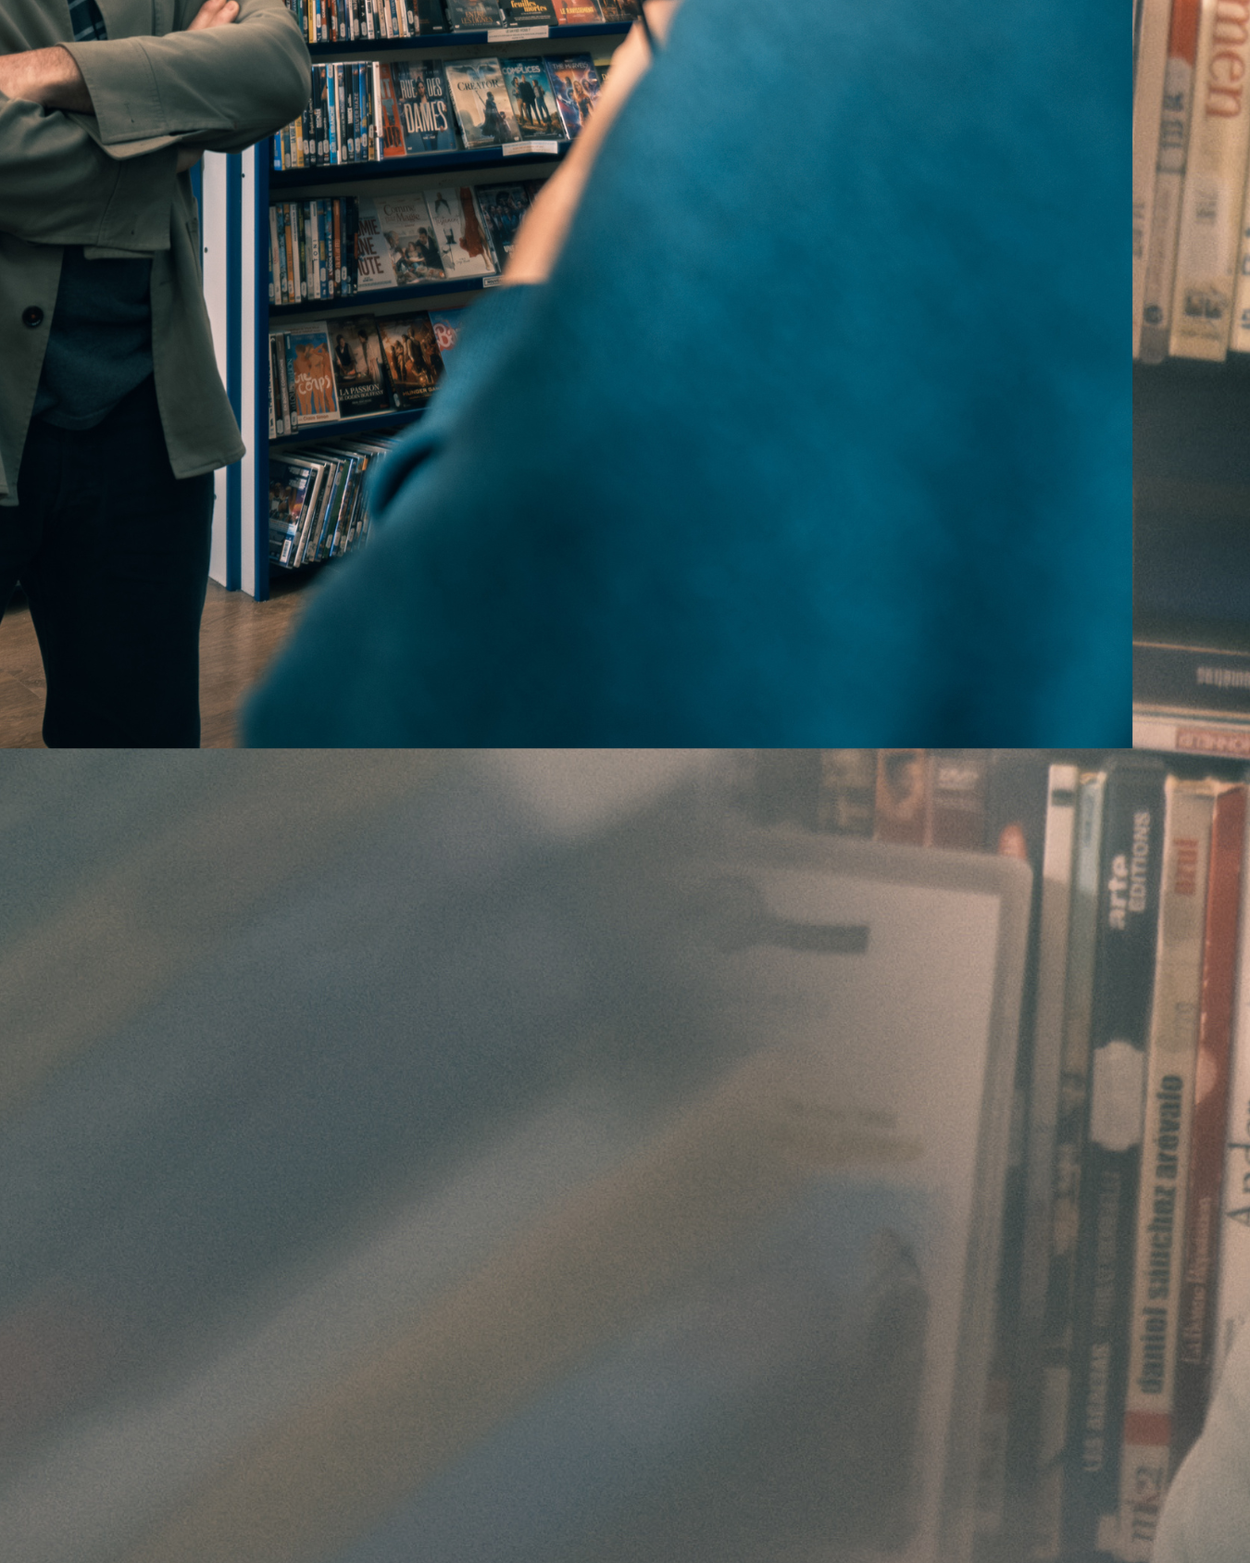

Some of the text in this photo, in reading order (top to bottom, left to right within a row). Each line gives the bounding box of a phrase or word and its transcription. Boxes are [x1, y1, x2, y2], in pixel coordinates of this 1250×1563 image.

[511, 0, 536, 8] feuilles
[502, 66, 541, 75] COMPLICES
[400, 78, 442, 98] RUE DES
[457, 80, 499, 91] CREATOR
[404, 101, 448, 133] DAMES
[383, 204, 416, 215] Comme
[396, 213, 420, 222] Magie
[351, 384, 379, 395] PASSION
[1127, 812, 1151, 912] EDITIONS
[1106, 855, 1129, 929] arte
[1139, 1306, 1169, 1395] daniel
